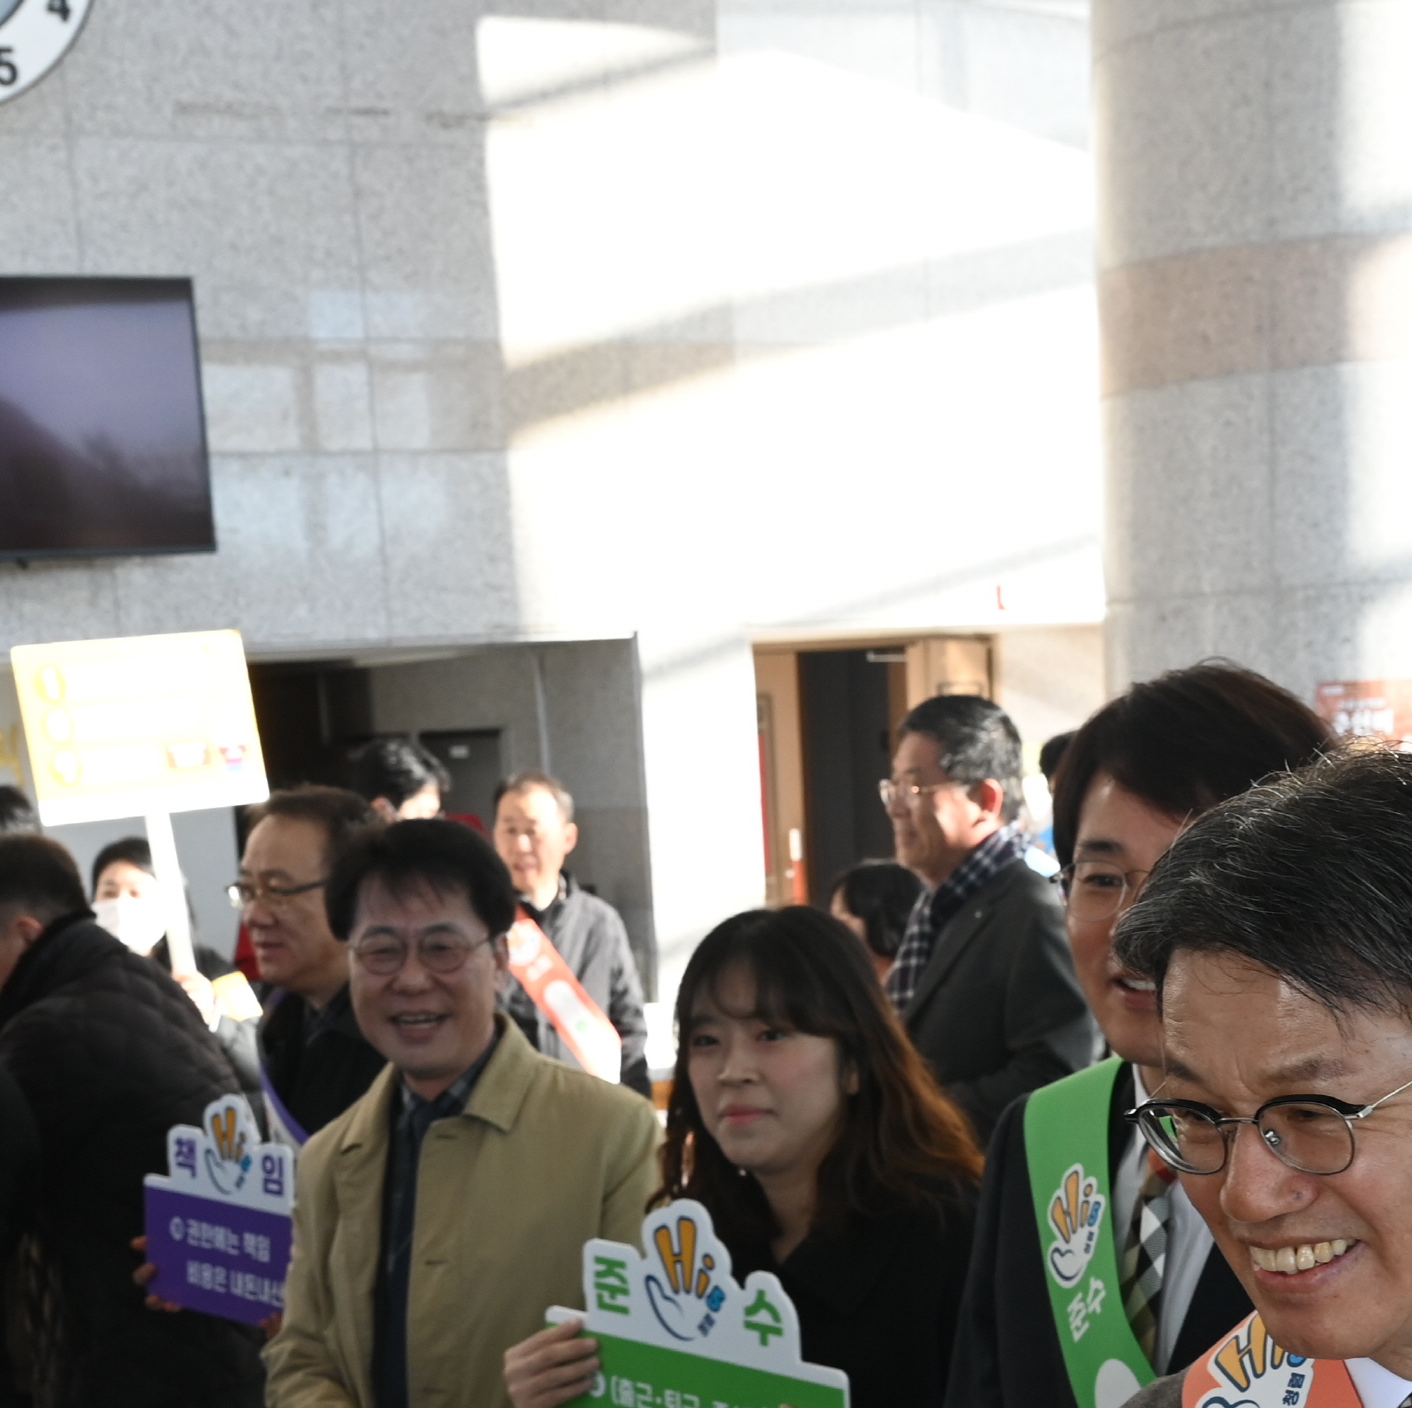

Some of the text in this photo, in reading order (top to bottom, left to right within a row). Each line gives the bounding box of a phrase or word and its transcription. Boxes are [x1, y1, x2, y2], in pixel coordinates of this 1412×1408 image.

[174, 1136, 198, 1179] 책
[262, 1154, 284, 1197] 임
[593, 1254, 631, 1317] 준
[1066, 1276, 1107, 1344] 준수
[742, 1287, 784, 1347] 수
